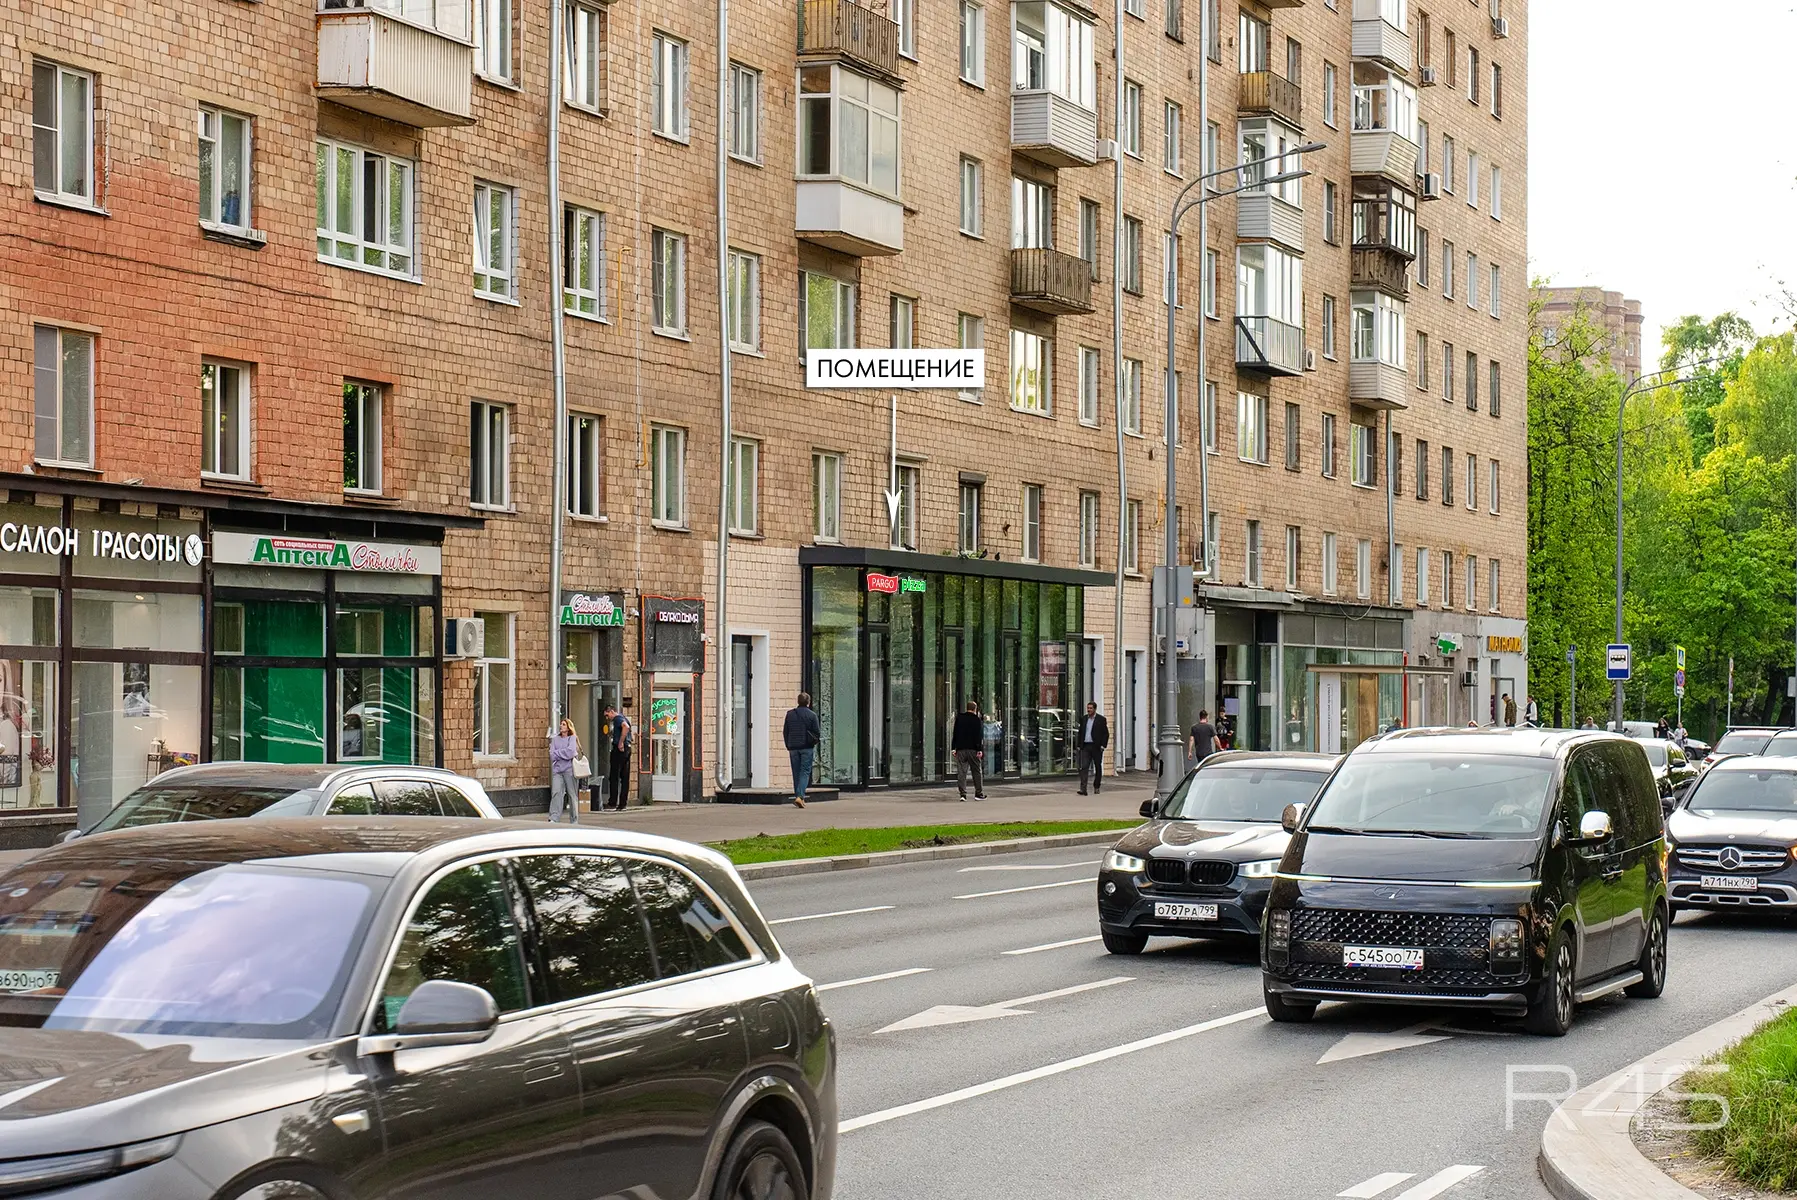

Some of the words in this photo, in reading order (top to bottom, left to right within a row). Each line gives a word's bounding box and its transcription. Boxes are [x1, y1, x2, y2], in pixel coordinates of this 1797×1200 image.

[1, 522, 78, 556] САЛОН
[352, 544, 419, 571] Столички
[871, 578, 895, 588] PARGO
[901, 576, 927, 594] pizza
[1199, 905, 1215, 914] 799
[1405, 950, 1419, 960] 77
